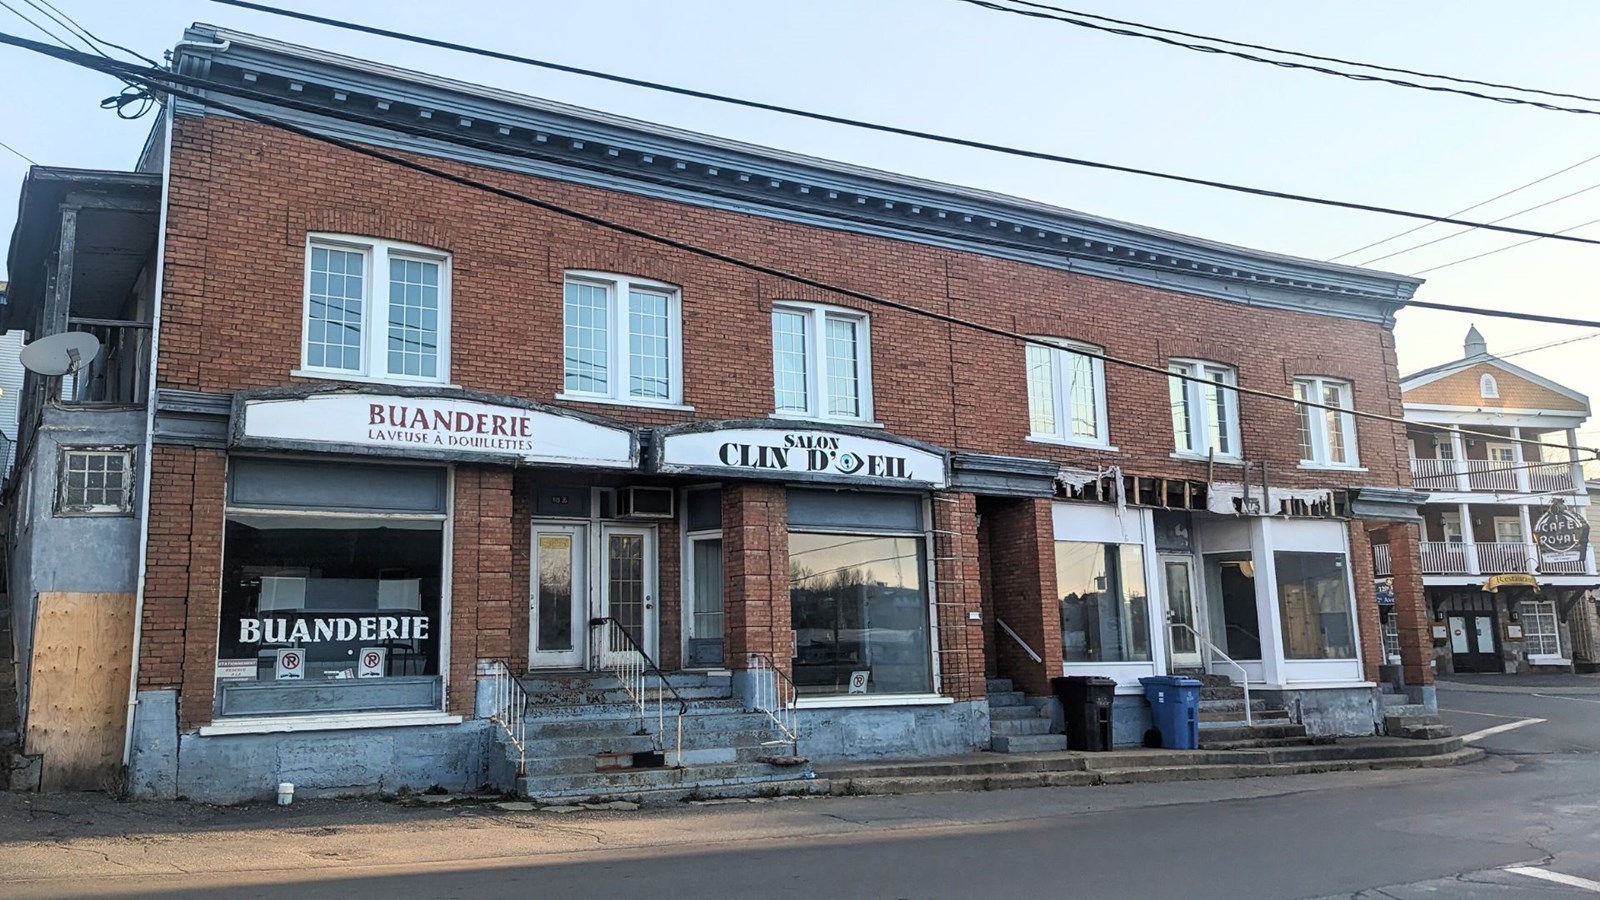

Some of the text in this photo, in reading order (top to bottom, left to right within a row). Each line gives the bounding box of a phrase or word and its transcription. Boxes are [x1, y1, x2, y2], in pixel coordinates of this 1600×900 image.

[368, 403, 533, 438] BUANDERIE
[368, 429, 533, 451] LAVEUSE À DOUILLETTES
[784, 434, 840, 450] SALON
[718, 442, 790, 470] CLIN
[1541, 520, 1575, 532] CAFE
[1540, 533, 1580, 546] ROYAL
[239, 616, 430, 643] BUANDERIE
